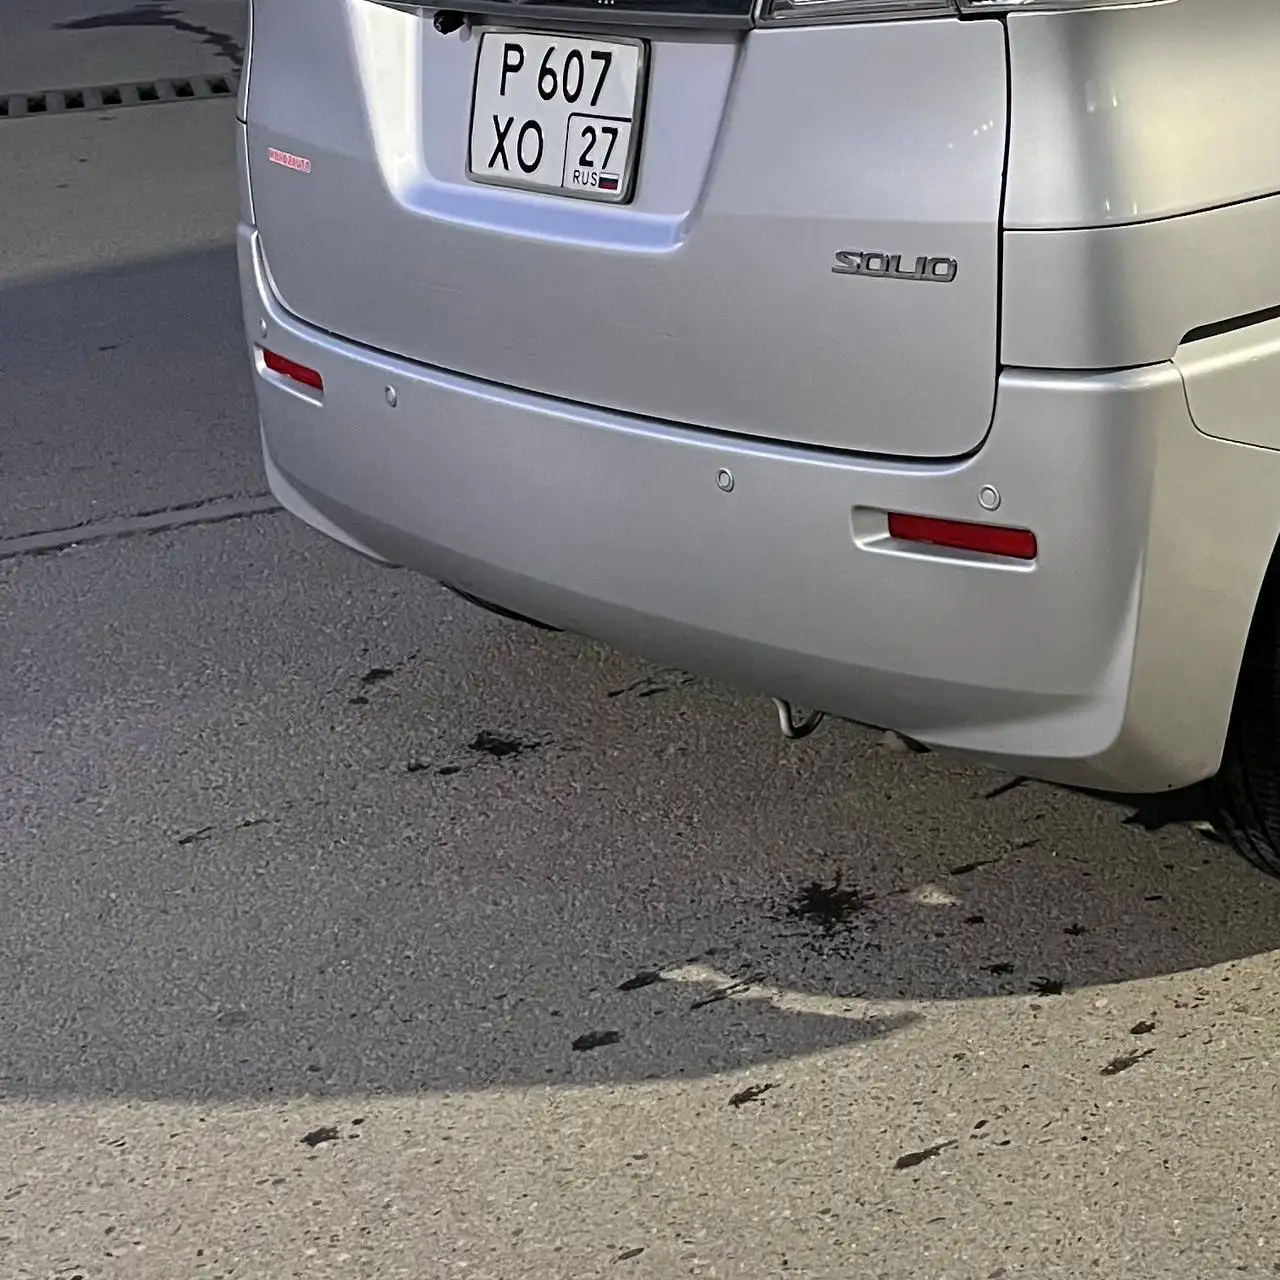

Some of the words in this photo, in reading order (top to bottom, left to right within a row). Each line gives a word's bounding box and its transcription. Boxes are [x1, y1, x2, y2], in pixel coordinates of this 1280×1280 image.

[537, 46, 613, 107] 607
[578, 124, 619, 171] 27
[572, 169, 598, 187] RUS
[831, 250, 958, 283] SOLIO
